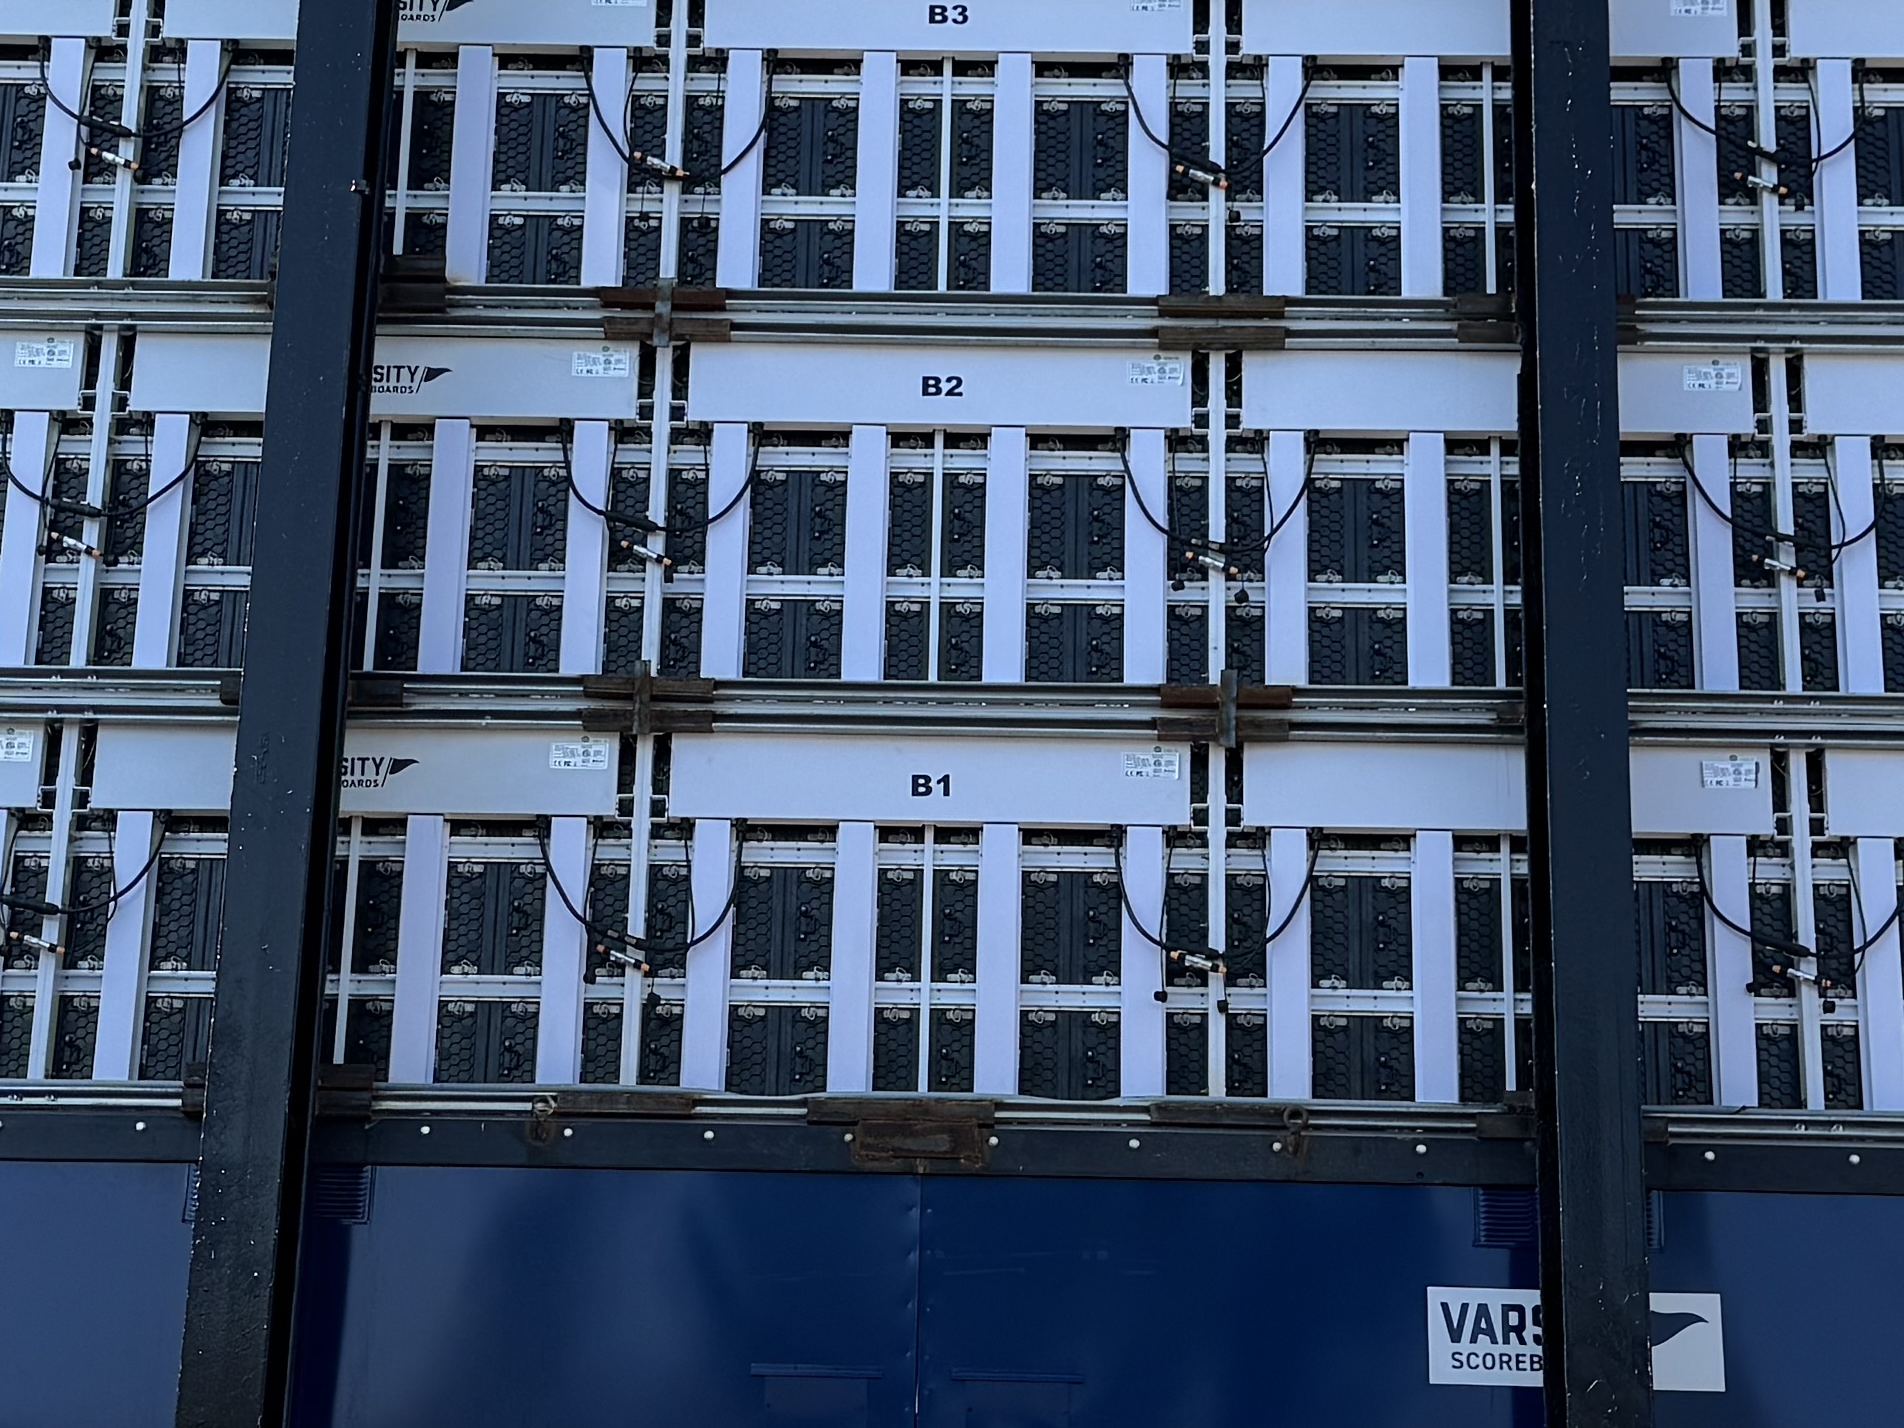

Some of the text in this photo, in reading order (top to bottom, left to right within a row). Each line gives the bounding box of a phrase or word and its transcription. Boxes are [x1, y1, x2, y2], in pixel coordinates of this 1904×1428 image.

[928, 5, 969, 25] B3
[373, 365, 420, 383] SITY
[921, 376, 964, 397] B2
[911, 774, 951, 797] B1
[1451, 1351, 1543, 1372] SCOREB
